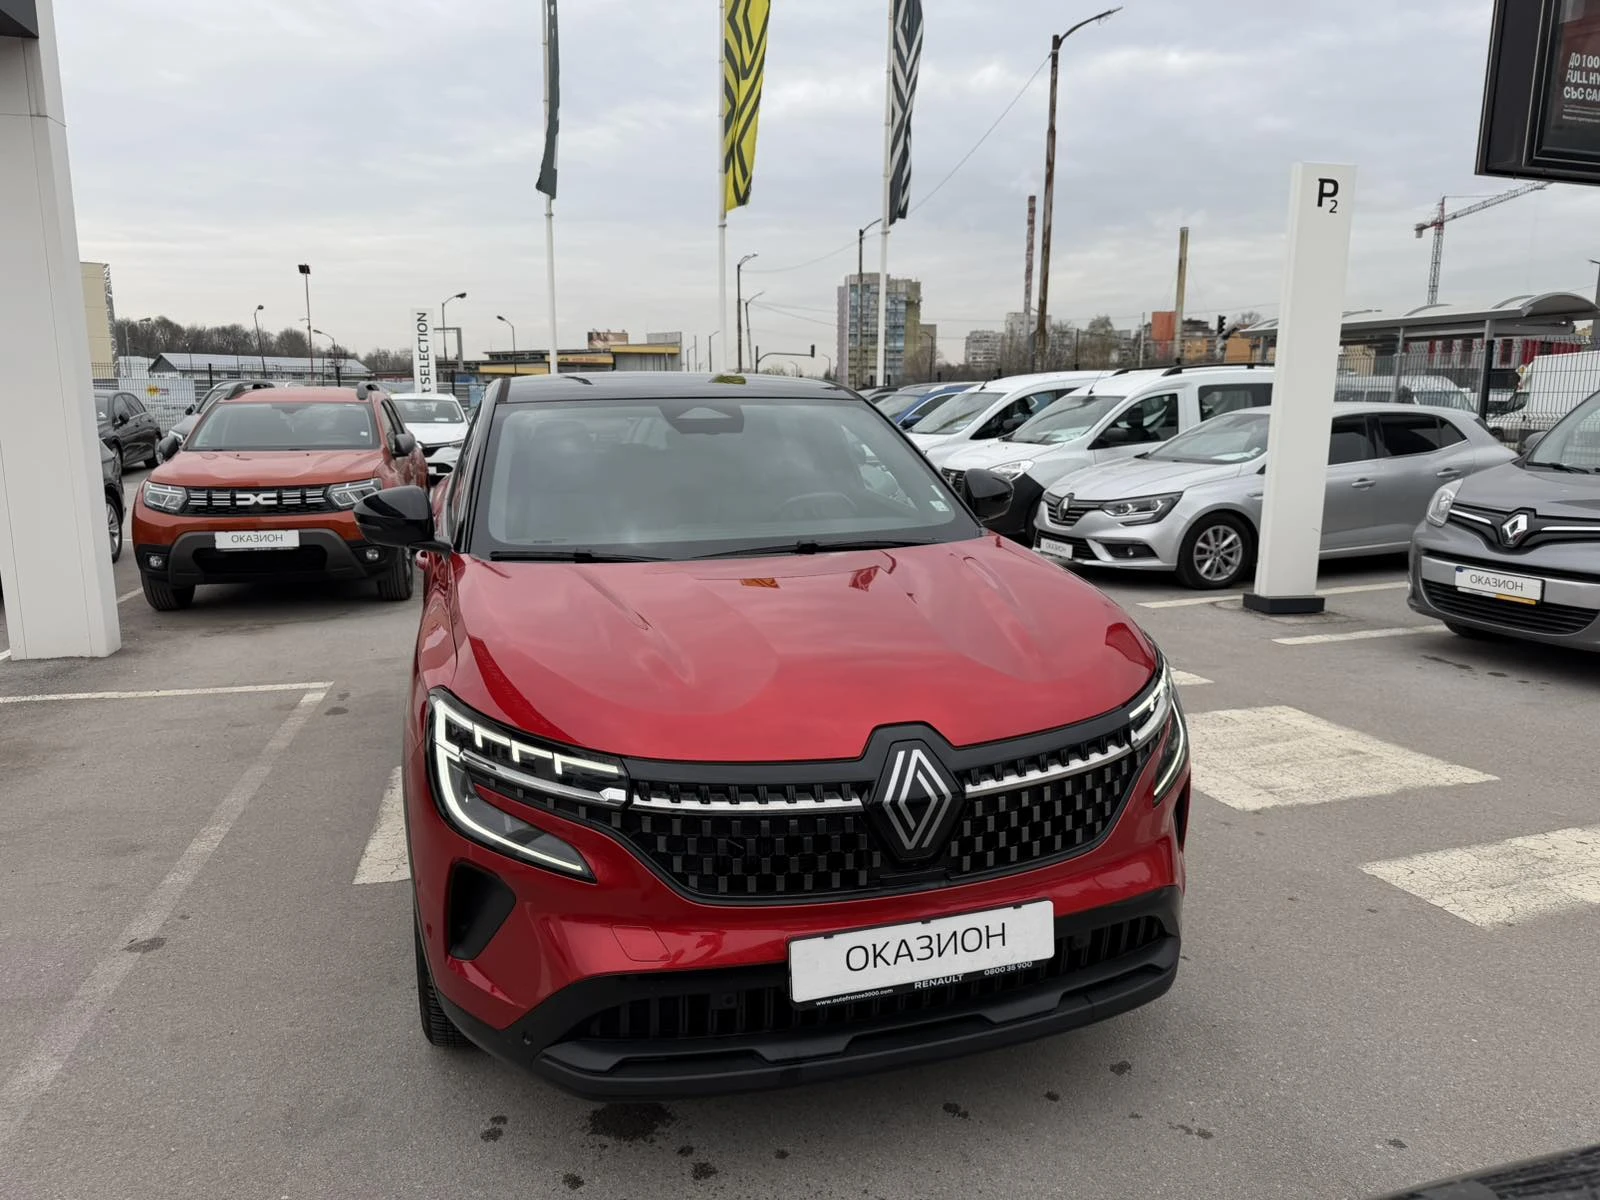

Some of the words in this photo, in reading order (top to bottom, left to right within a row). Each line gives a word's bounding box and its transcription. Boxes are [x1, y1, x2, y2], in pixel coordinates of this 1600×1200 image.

[1565, 69, 1588, 84] FULL
[416, 312, 431, 385] SELECTION
[230, 533, 284, 544] ОКАЗИОН
[1469, 574, 1524, 592] ОКАЗИОН
[845, 921, 1007, 972] ОКАЗИОН
[983, 964, 1006, 976] 0800
[1006, 962, 1017, 972] 35
[1016, 960, 1033, 970] 900
[914, 974, 964, 990] RENAULT
